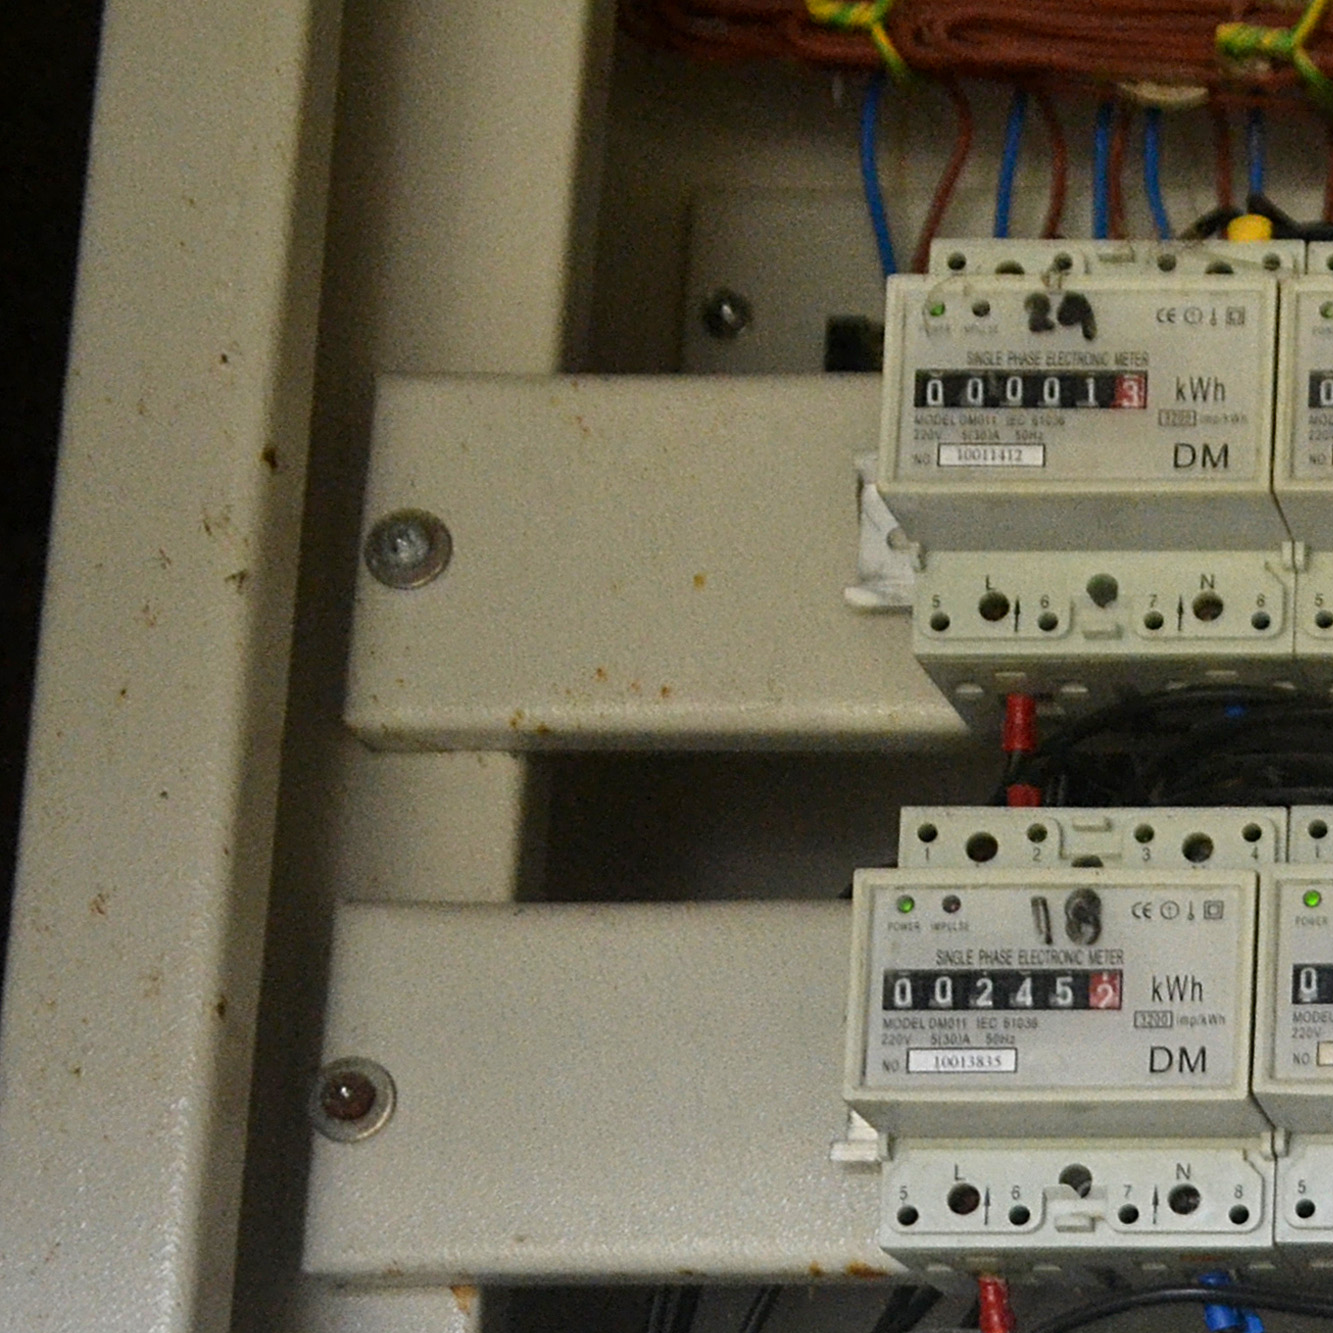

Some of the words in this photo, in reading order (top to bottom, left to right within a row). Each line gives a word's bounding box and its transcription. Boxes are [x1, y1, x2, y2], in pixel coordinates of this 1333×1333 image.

[919, 371, 1142, 406] 000013
[1175, 375, 1227, 402] kWh
[1172, 442, 1229, 469] DM
[1031, 887, 1103, 945] 18
[1151, 974, 1205, 1002] kWh
[1148, 1045, 1207, 1073] DM
